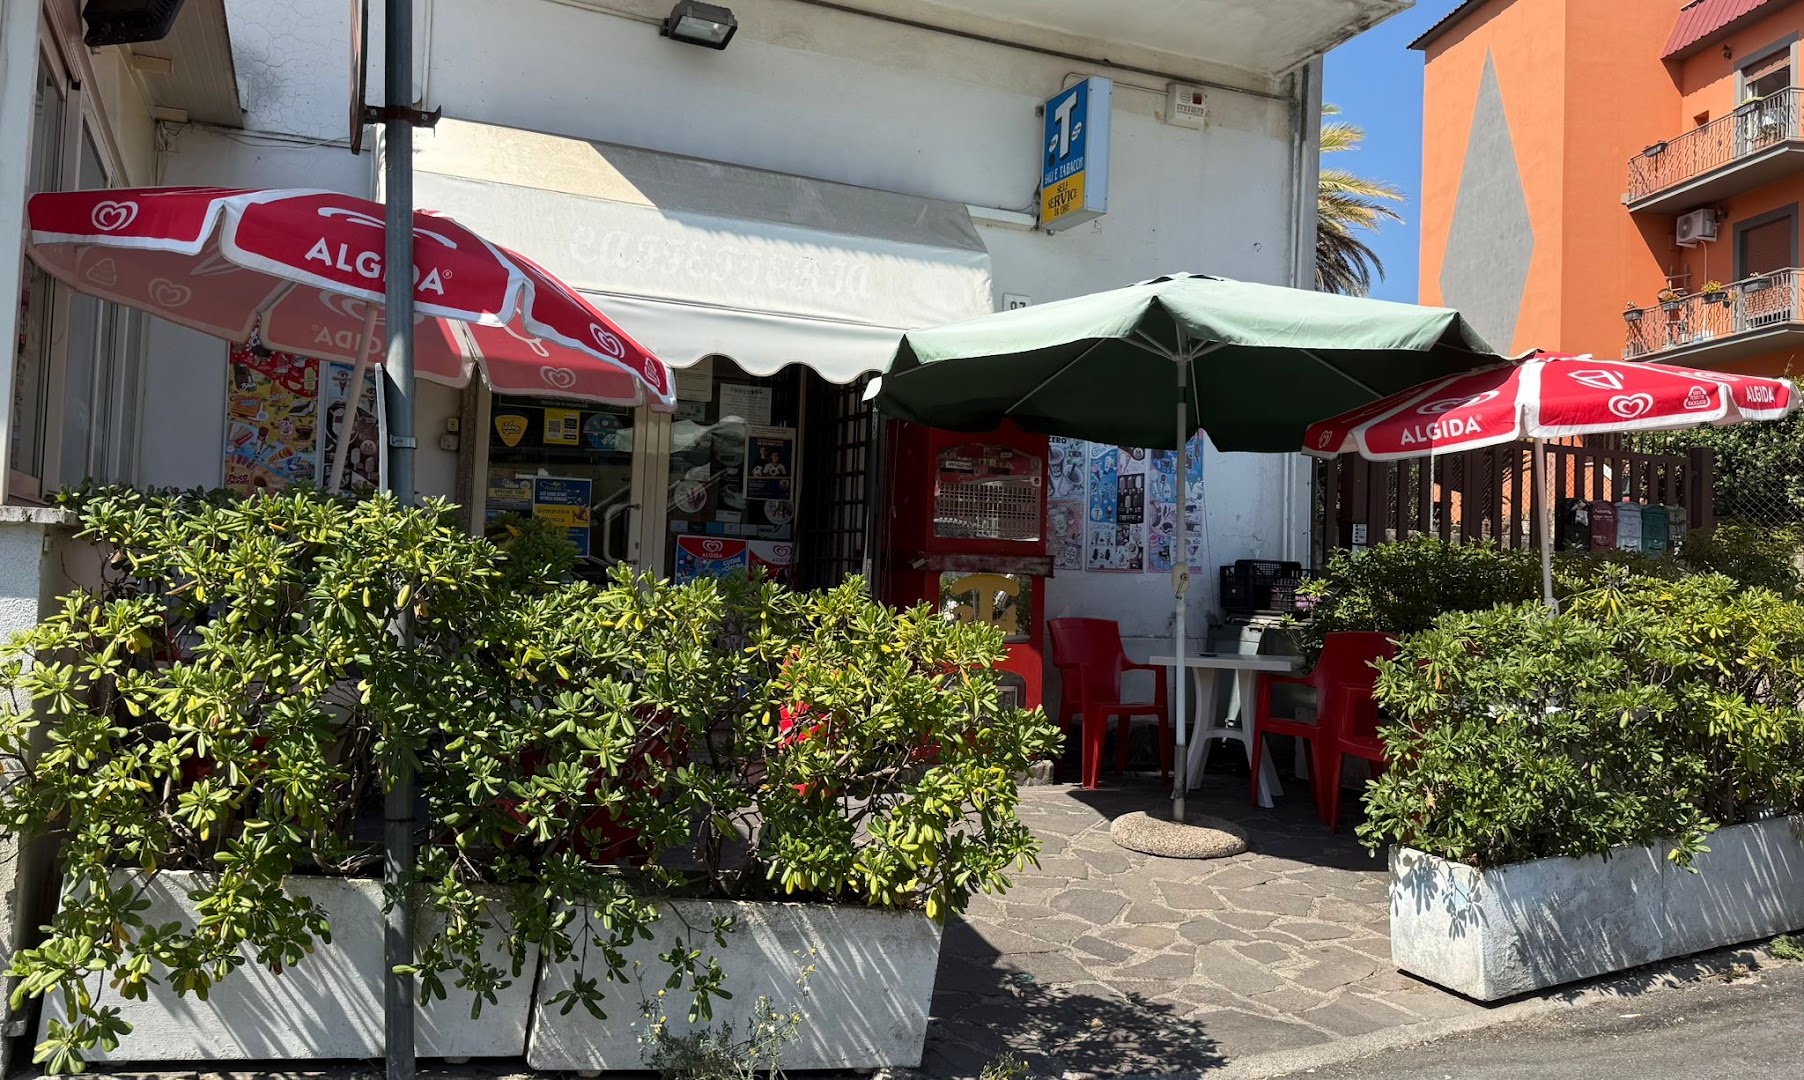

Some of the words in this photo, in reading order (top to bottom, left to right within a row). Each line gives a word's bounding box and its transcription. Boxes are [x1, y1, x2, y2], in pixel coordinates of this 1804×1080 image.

[1054, 90, 1077, 159] T
[1047, 187, 1078, 210] SERVICE
[1056, 181, 1069, 194] SELF
[305, 236, 445, 296] ALGA
[1746, 385, 1776, 403] ALGIDA
[1401, 415, 1482, 446] ALGIDA
